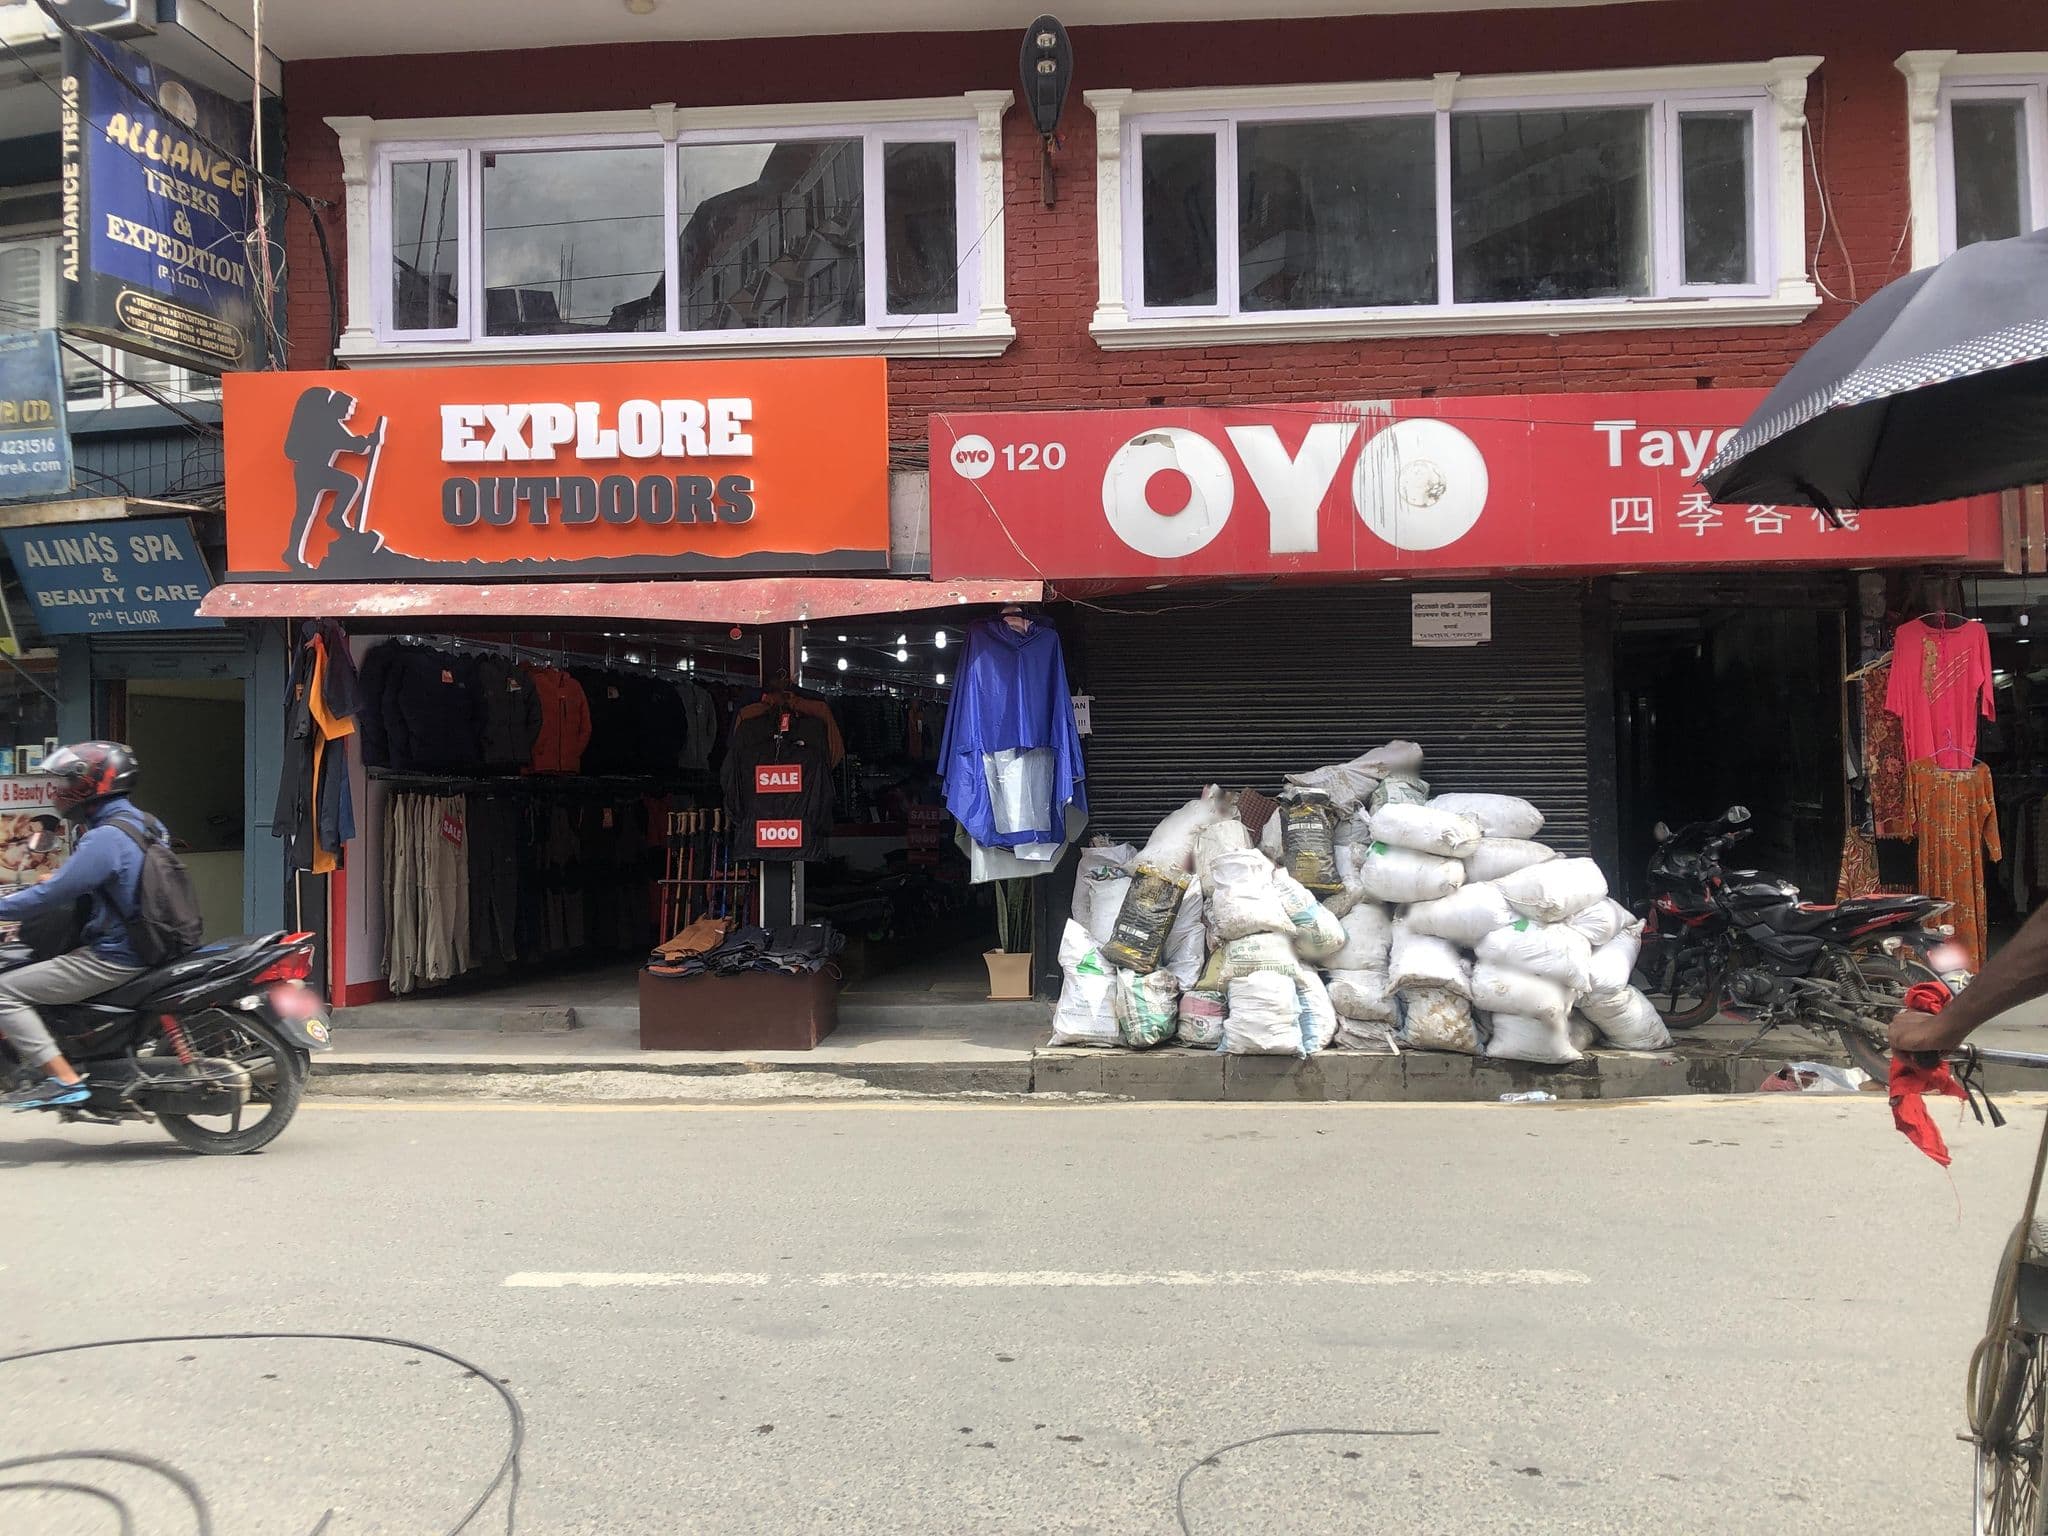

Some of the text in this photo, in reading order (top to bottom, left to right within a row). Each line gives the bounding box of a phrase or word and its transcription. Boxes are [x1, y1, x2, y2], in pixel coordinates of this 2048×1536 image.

[106, 112, 247, 197] ALLIANCE
[62, 75, 79, 282] ALLIANCE TREKS
[143, 167, 221, 219] TREKS
[172, 210, 191, 237] &
[106, 213, 246, 288] EXPEDITION
[439, 397, 753, 463] EXPLORE
[1001, 442, 1067, 470] 120
[441, 474, 756, 526] OUTDOORS
[1101, 417, 1489, 559] OYO
[24, 532, 184, 568] ALINA'S SPA
[102, 567, 118, 583] &
[36, 584, 202, 608] BEAUTY CARE
[88, 608, 161, 626] 2nd FLOOR
[759, 772, 799, 786] SALE
[443, 820, 462, 843] SALE
[759, 826, 799, 841] 1000
